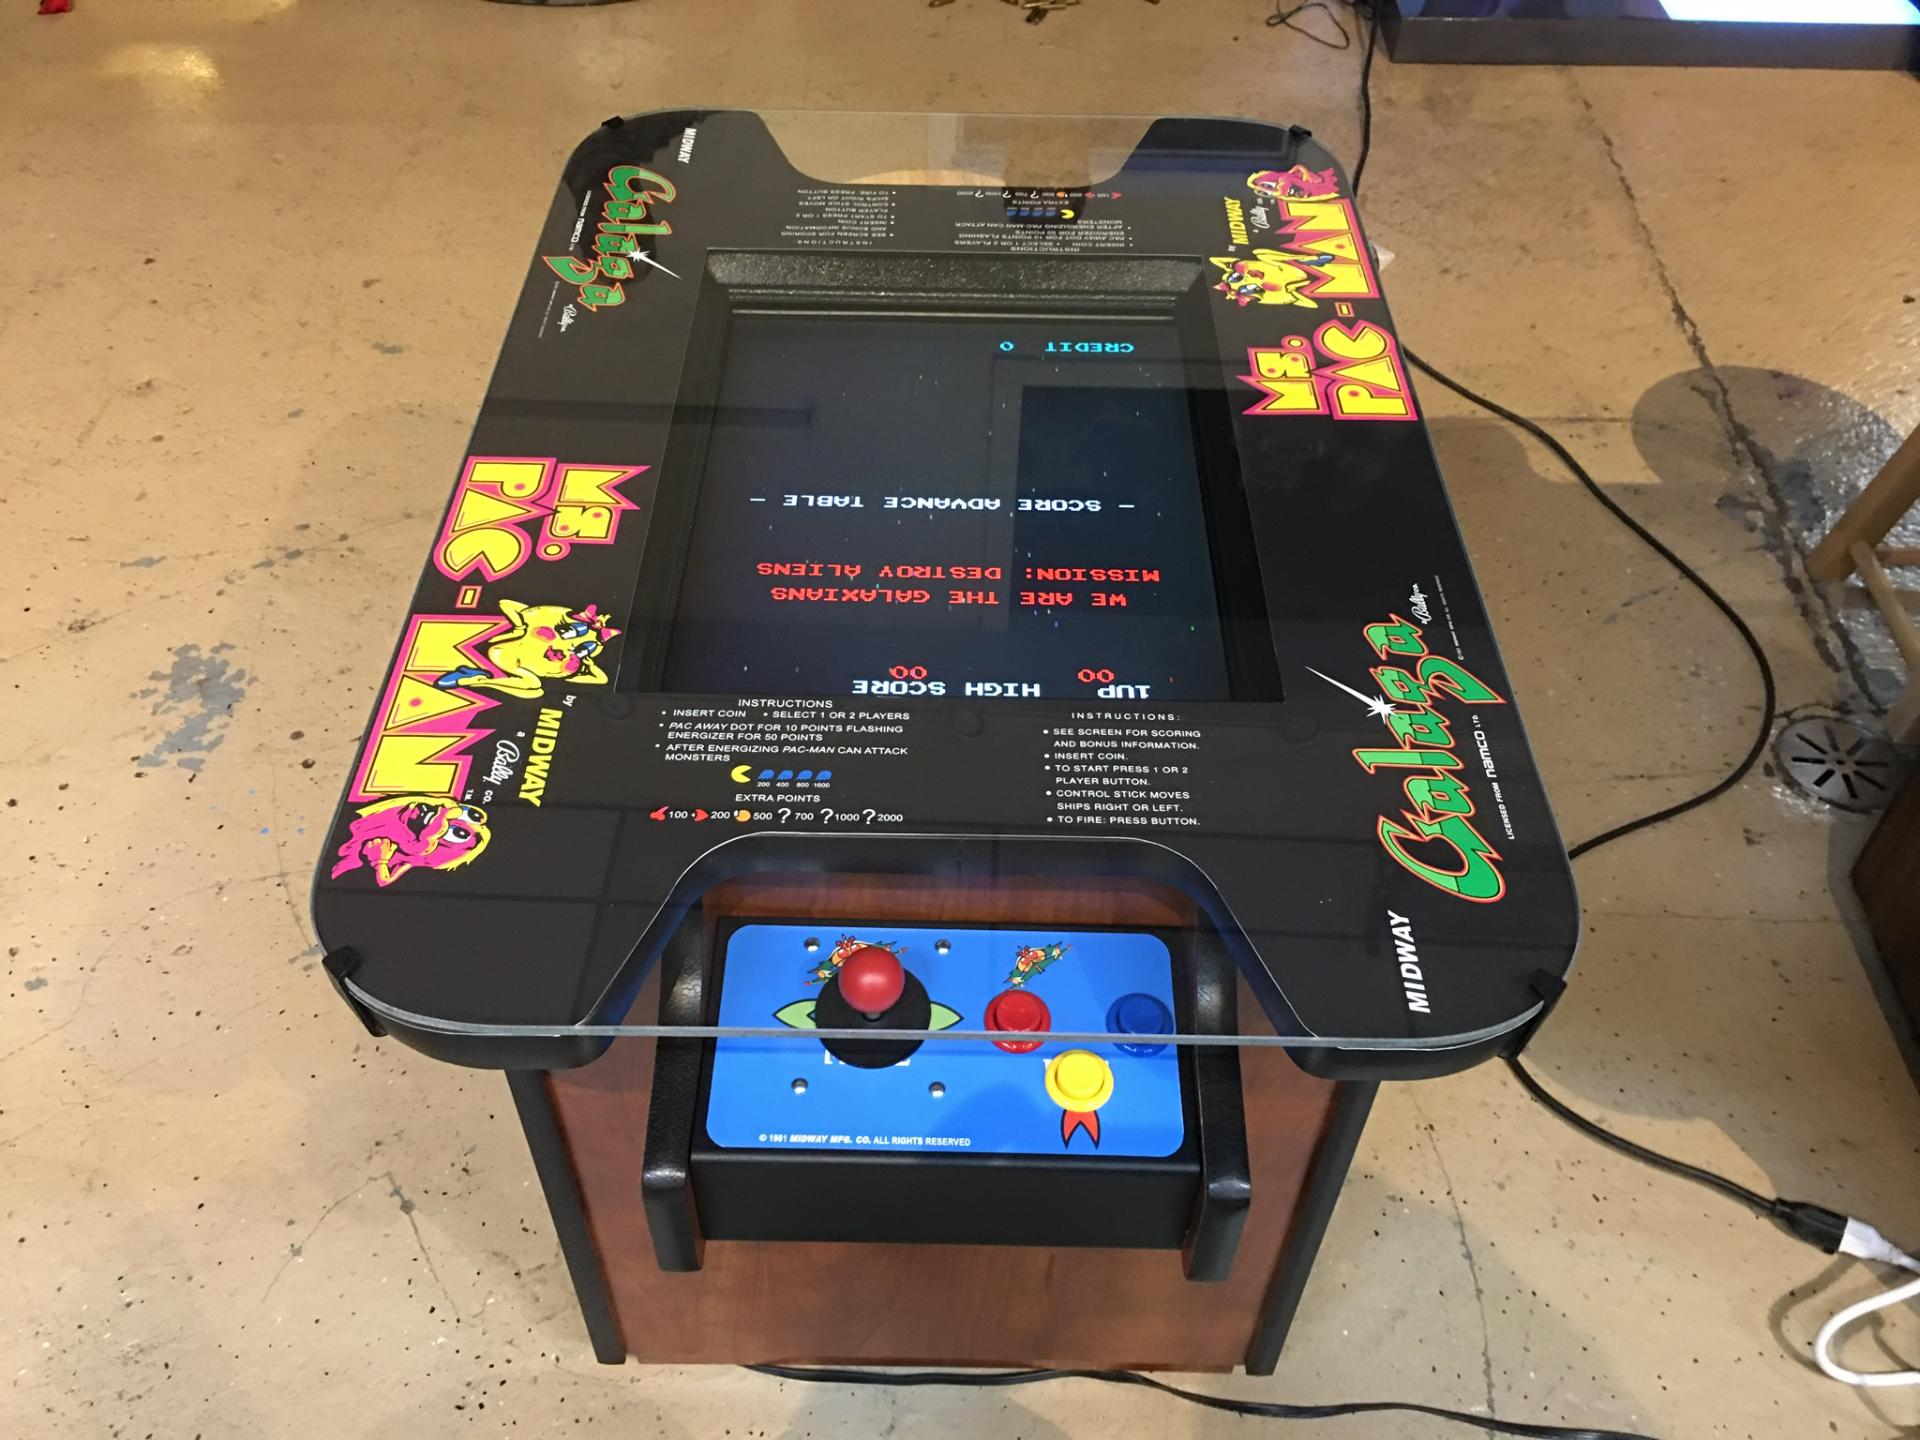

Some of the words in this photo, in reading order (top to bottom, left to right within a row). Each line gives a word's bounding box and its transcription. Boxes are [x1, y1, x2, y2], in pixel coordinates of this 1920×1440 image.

[678, 127, 697, 163] MIDWAY
[1224, 197, 1248, 245] MIDWAY
[571, 218, 585, 243] namco
[542, 164, 677, 312] Galaga
[1045, 342, 1134, 353] CREDIT
[783, 495, 864, 507] TABLE
[884, 497, 1000, 510] ADVANCE
[1017, 499, 1101, 511] SCORE
[757, 562, 861, 577] ALIENS
[879, 566, 1000, 579] DESTROY
[1026, 567, 1159, 582] MISSION:
[771, 587, 929, 603] GALAXIANS
[949, 591, 999, 604] THE
[1021, 592, 1072, 605] ARE
[1091, 593, 1126, 606] WE
[1409, 588, 1432, 622] Bally
[889, 665, 927, 679] 00
[1077, 669, 1114, 683] 00
[852, 680, 946, 696] SCORE
[965, 682, 1041, 697] HIGH
[1097, 684, 1150, 699] 1UP
[563, 694, 577, 707] by
[738, 699, 833, 708] INSTRUCTIONS
[673, 709, 715, 717] INSERT
[772, 711, 817, 719] SELECT
[829, 711, 847, 719] OR
[858, 711, 910, 720] PLAYERS
[1072, 712, 1180, 721] INSTRUCTIONS:
[516, 730, 526, 738] a
[669, 722, 696, 730] PAC
[698, 723, 728, 731] AWAY
[730, 723, 756, 731] DOT
[757, 723, 782, 731] FOR
[786, 724, 798, 732] 10
[800, 724, 843, 733] POINTS
[846, 725, 903, 733] FLASHING
[1126, 729, 1148, 737] FOR
[1151, 729, 1201, 738] SCORING
[667, 732, 734, 740] ENERGIZER
[765, 733, 779, 741] 50
[780, 733, 823, 741] POINTS
[666, 744, 705, 752] AFTER
[708, 745, 779, 753] ENERGIZING
[782, 746, 835, 754] PAC-MAN
[838, 746, 862, 755] CAN
[864, 747, 908, 755] ATTACK
[1121, 741, 1200, 750] INFORMATION.
[519, 706, 563, 807] MIDWAY
[665, 753, 730, 762] MONSTERS
[1352, 613, 1506, 903] Galaga
[1474, 730, 1498, 779] namco
[482, 739, 520, 786] Bally
[1113, 765, 1150, 773] PRESS
[1056, 777, 1099, 785] PLAYER
[1102, 778, 1151, 786] BUTTON.
[735, 794, 774, 802] EXTRA
[777, 794, 821, 802] POINTS
[1150, 791, 1190, 799] MOVES
[1491, 782, 1506, 802] FROM
[1095, 803, 1128, 811] RIGHT
[1152, 804, 1183, 812] LEFT.
[669, 810, 688, 819] 100
[710, 810, 730, 819] 200
[753, 812, 773, 820] 500
[795, 812, 814, 821] 700
[834, 813, 860, 821] 1000
[877, 814, 903, 822] 2000
[1077, 816, 1106, 824] FIRE:
[1151, 817, 1201, 826] BUTTON.
[1497, 799, 1515, 840] LICENSED
[1387, 909, 1430, 1013] MIDWAY
[789, 1134, 828, 1143] MIDWAY
[829, 1135, 852, 1144] MFG.
[856, 1136, 871, 1144] CO.
[873, 1136, 890, 1145] ALL
[891, 1136, 923, 1145] RIGHTS
[925, 1137, 971, 1147] RESERVED
